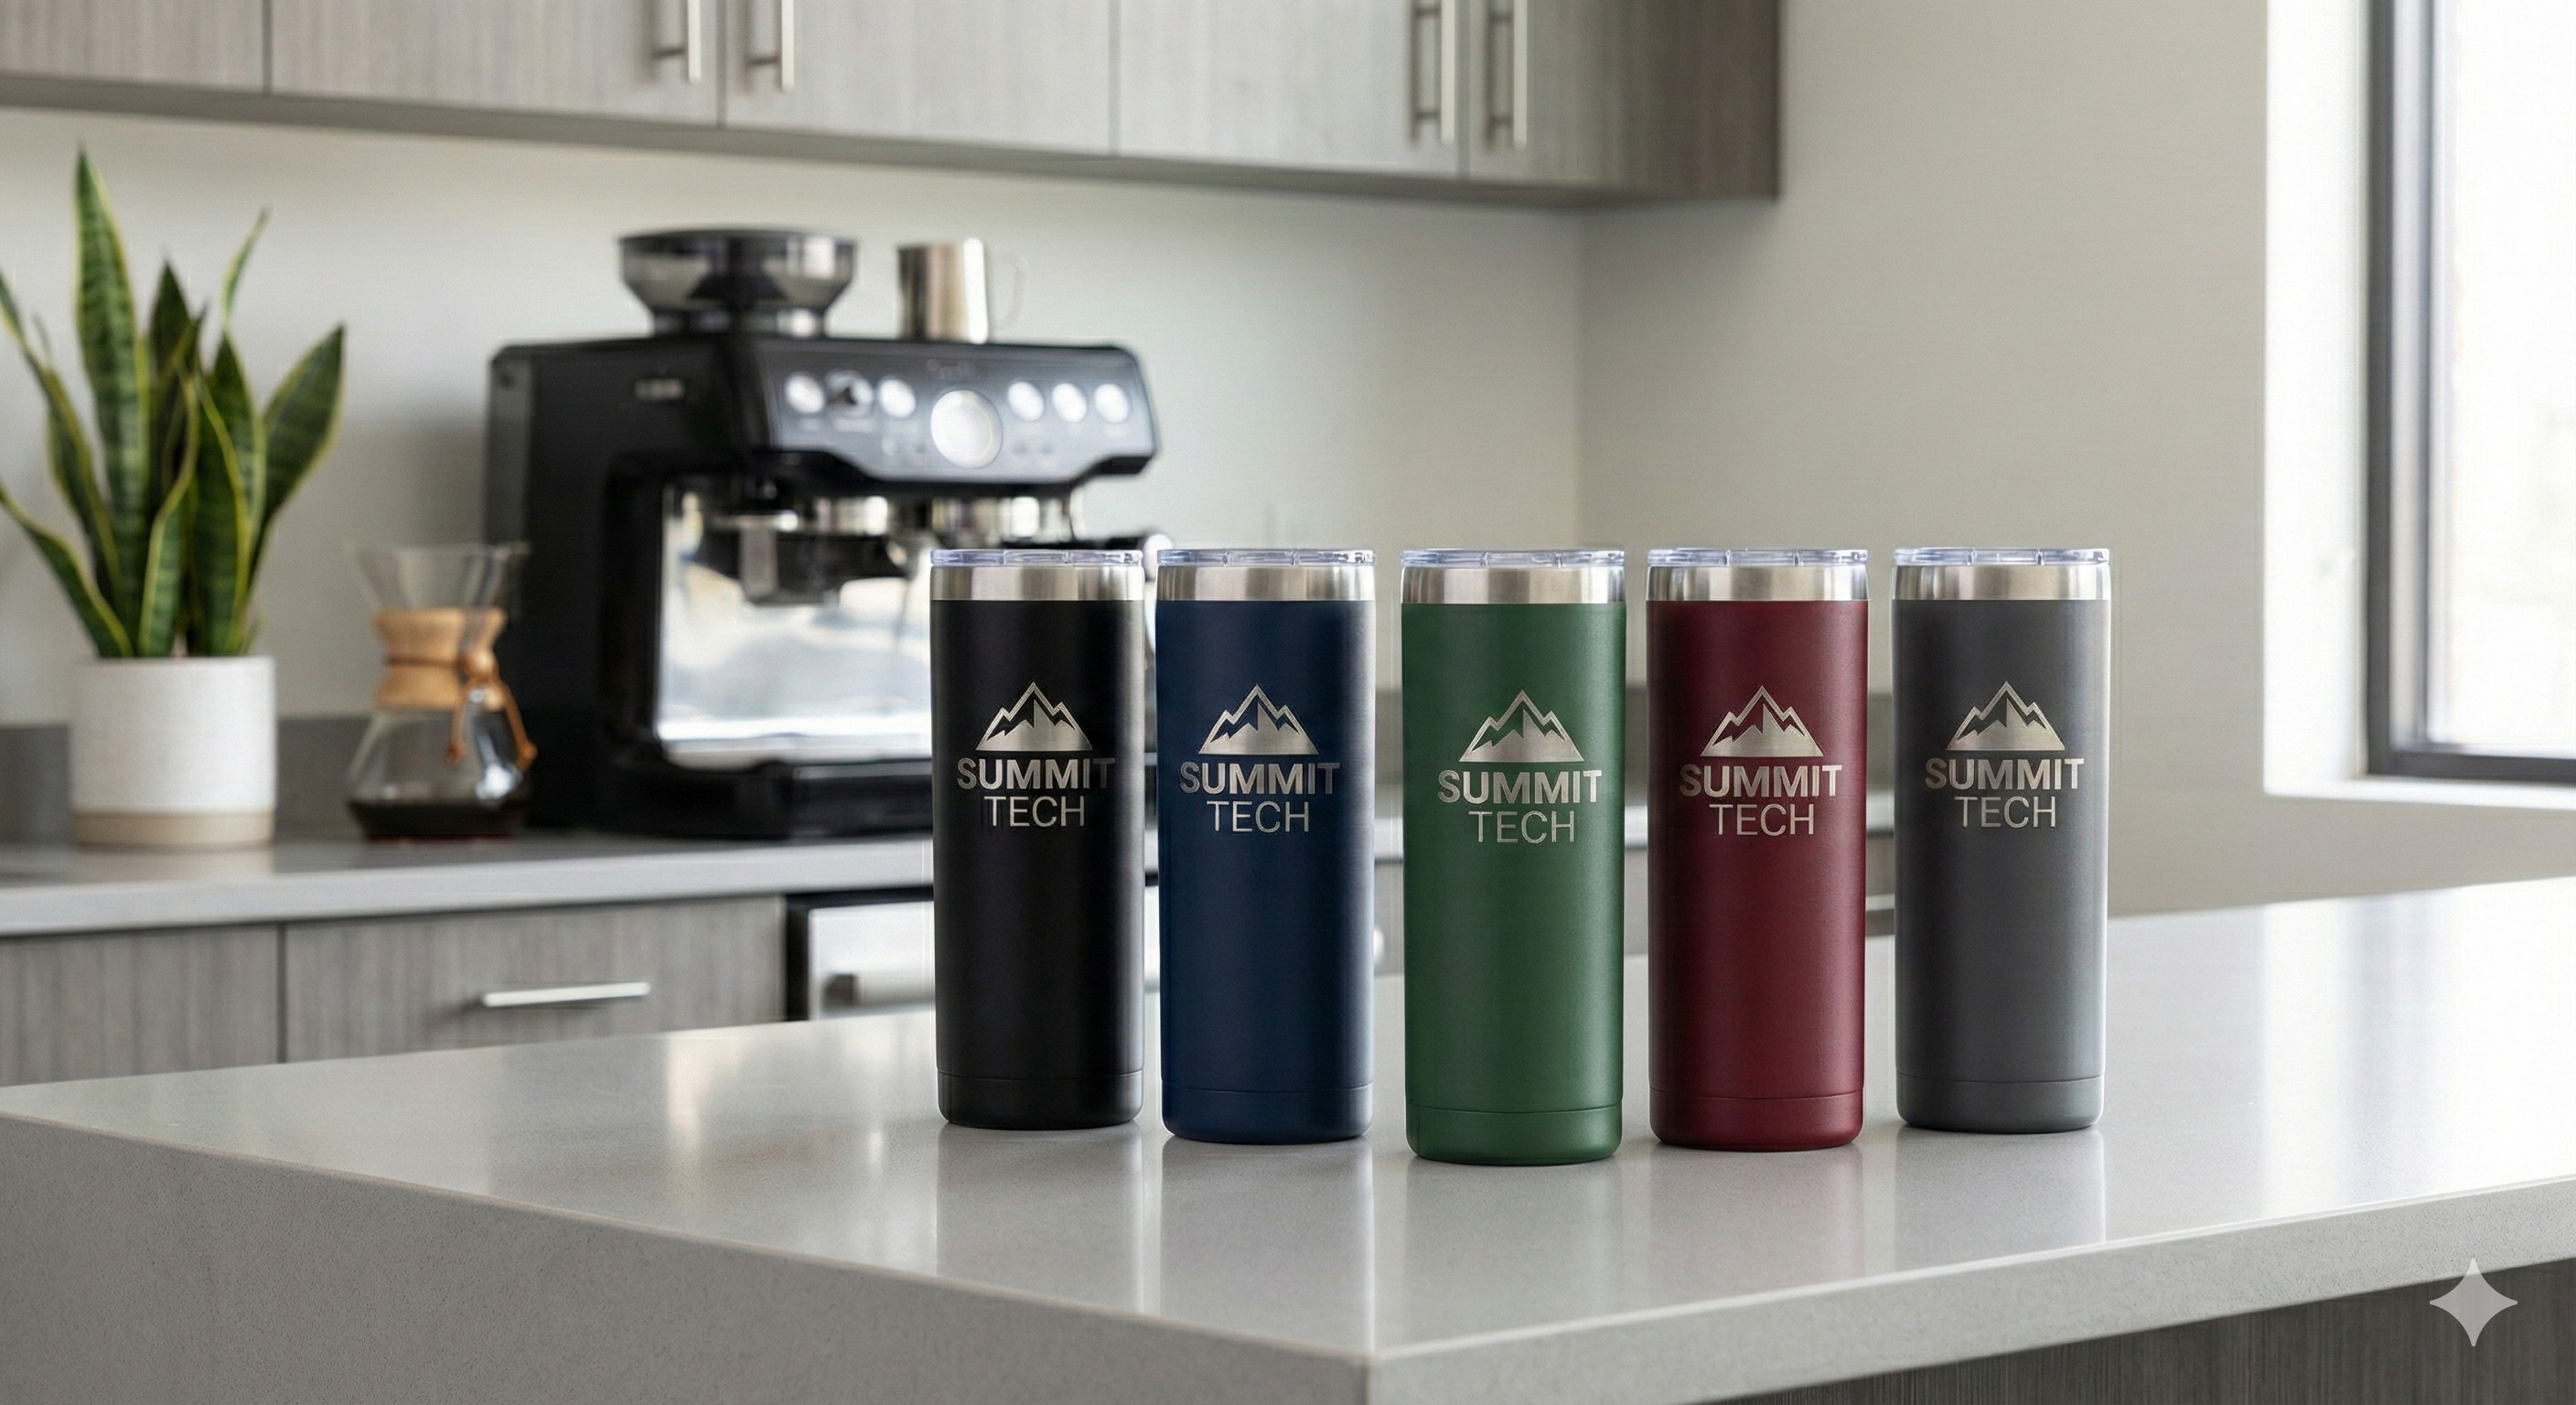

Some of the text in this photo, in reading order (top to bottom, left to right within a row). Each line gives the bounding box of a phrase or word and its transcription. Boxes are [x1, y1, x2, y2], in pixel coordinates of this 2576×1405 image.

[957, 756, 1115, 789] SUMMIT
[1180, 762, 1340, 794] SUMMIT
[1437, 769, 1602, 804] SUMMIT
[1680, 764, 1842, 798] SUMMIT
[1925, 757, 2083, 790] SUMMIT
[984, 795, 1085, 828] TECH
[1207, 801, 1309, 832] TECH
[1469, 810, 1574, 843] TECH
[1709, 803, 1814, 837] TECH
[1954, 796, 2056, 828] TECH
